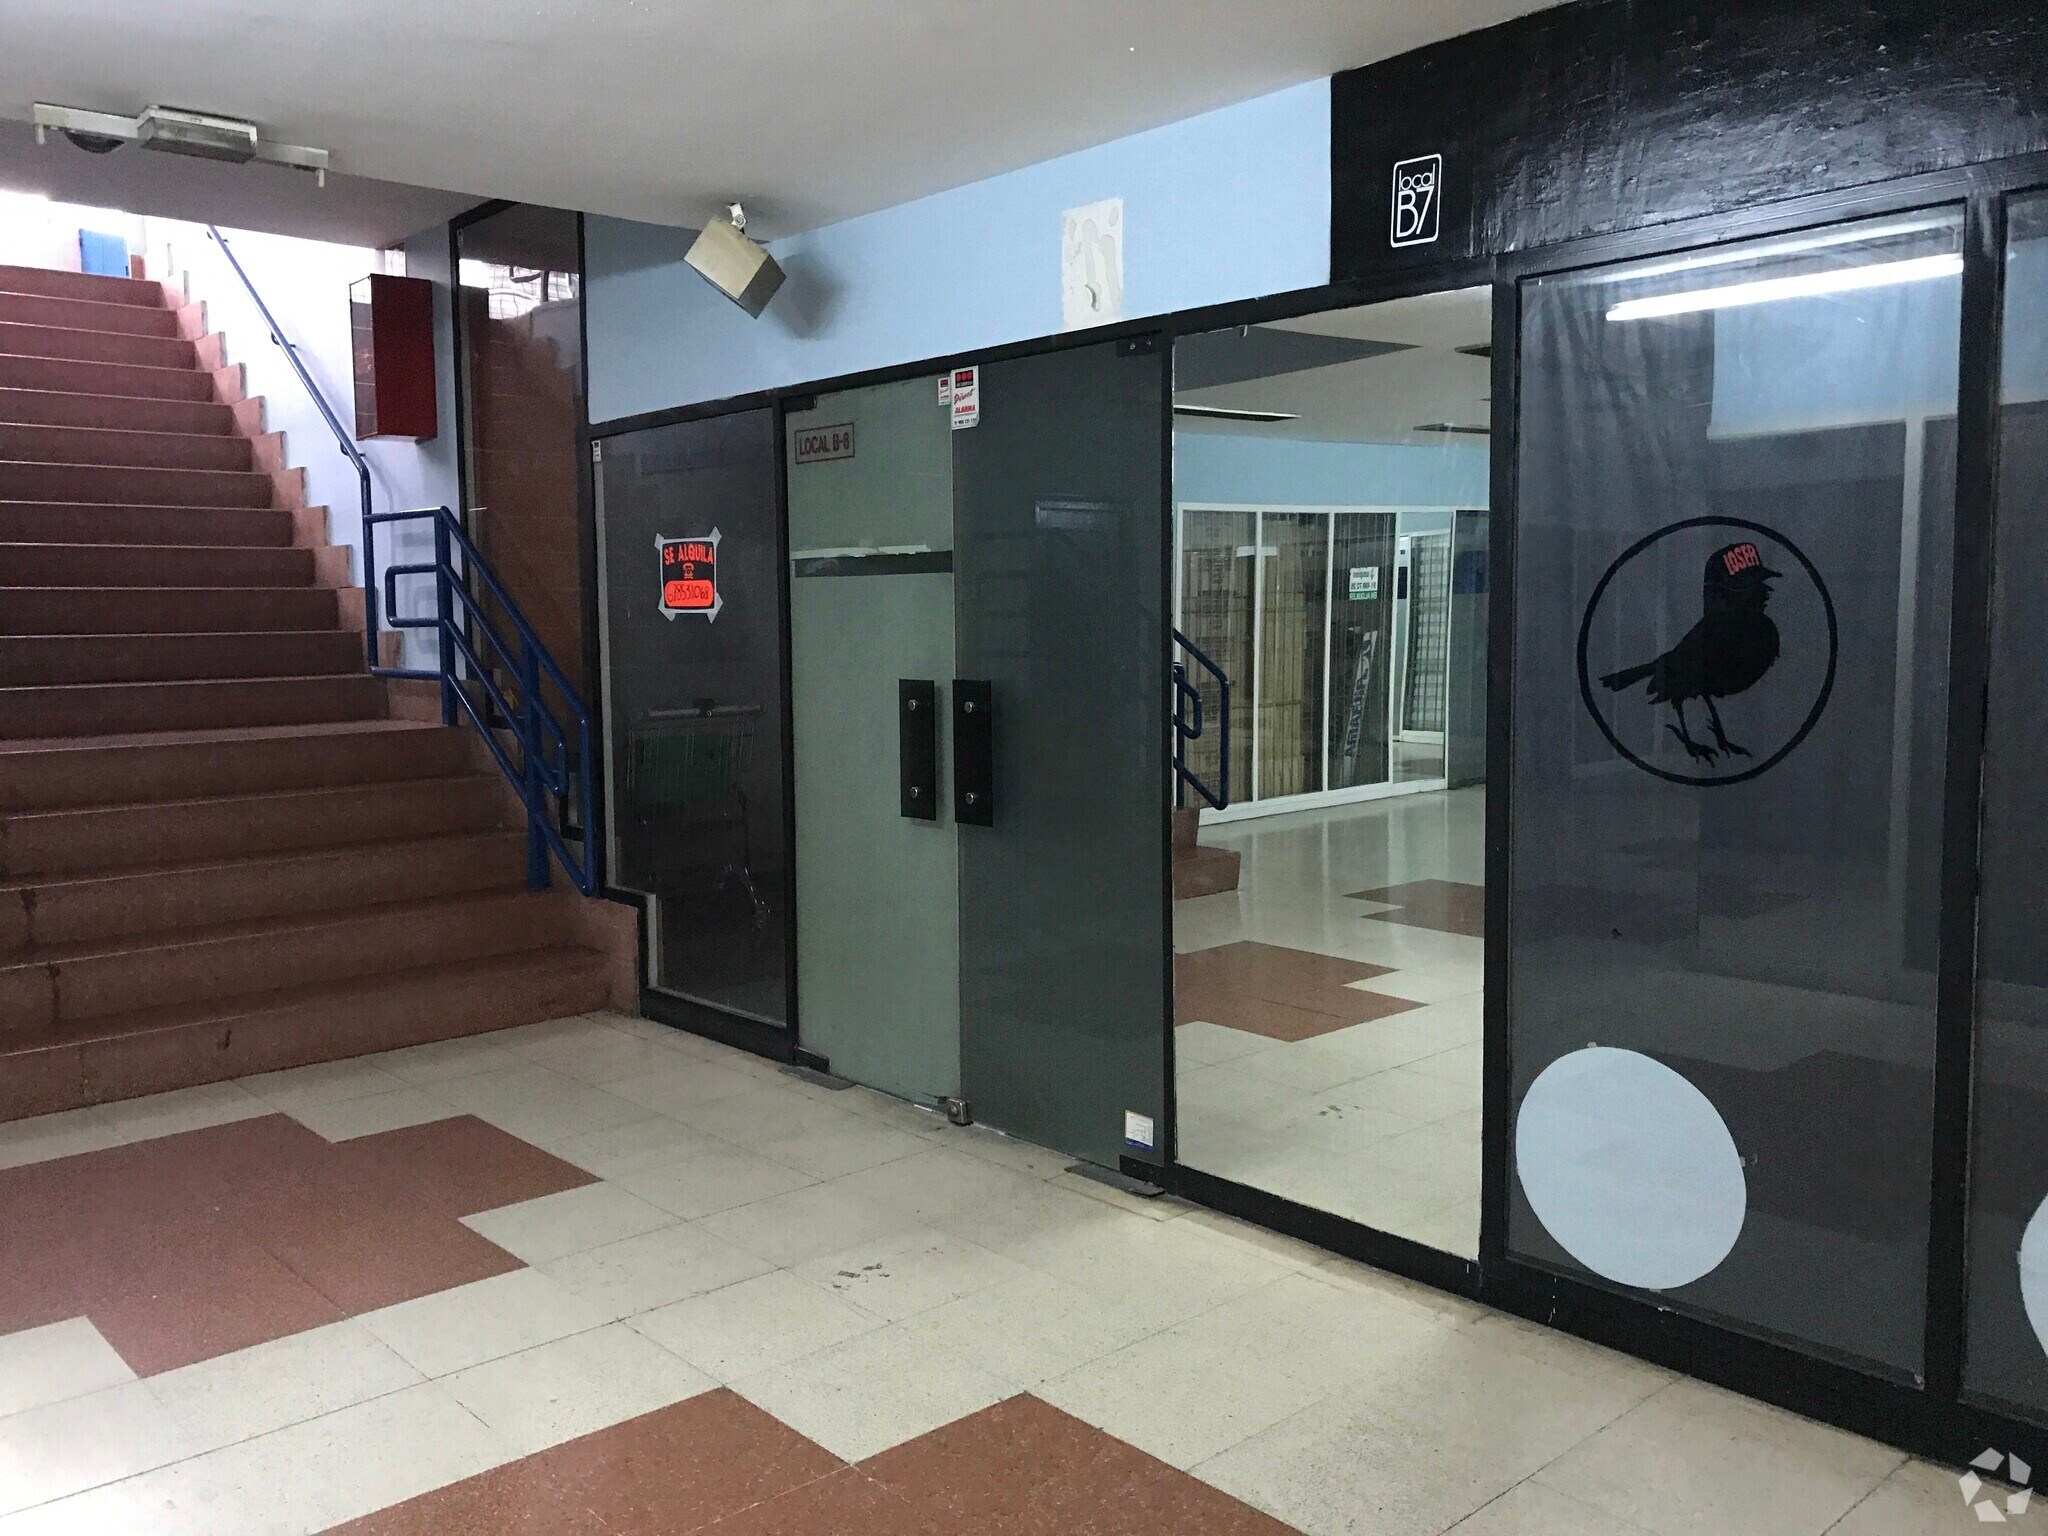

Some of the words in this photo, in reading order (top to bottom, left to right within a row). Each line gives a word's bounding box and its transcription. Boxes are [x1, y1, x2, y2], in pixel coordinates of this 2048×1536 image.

[1398, 163, 1436, 191] local
[1396, 185, 1435, 238] B7
[955, 405, 976, 414] ALARMA
[799, 435, 830, 456] LOCAL
[664, 546, 675, 565] SE
[678, 543, 714, 564] ALQUILA
[1723, 544, 1760, 576] LOSER
